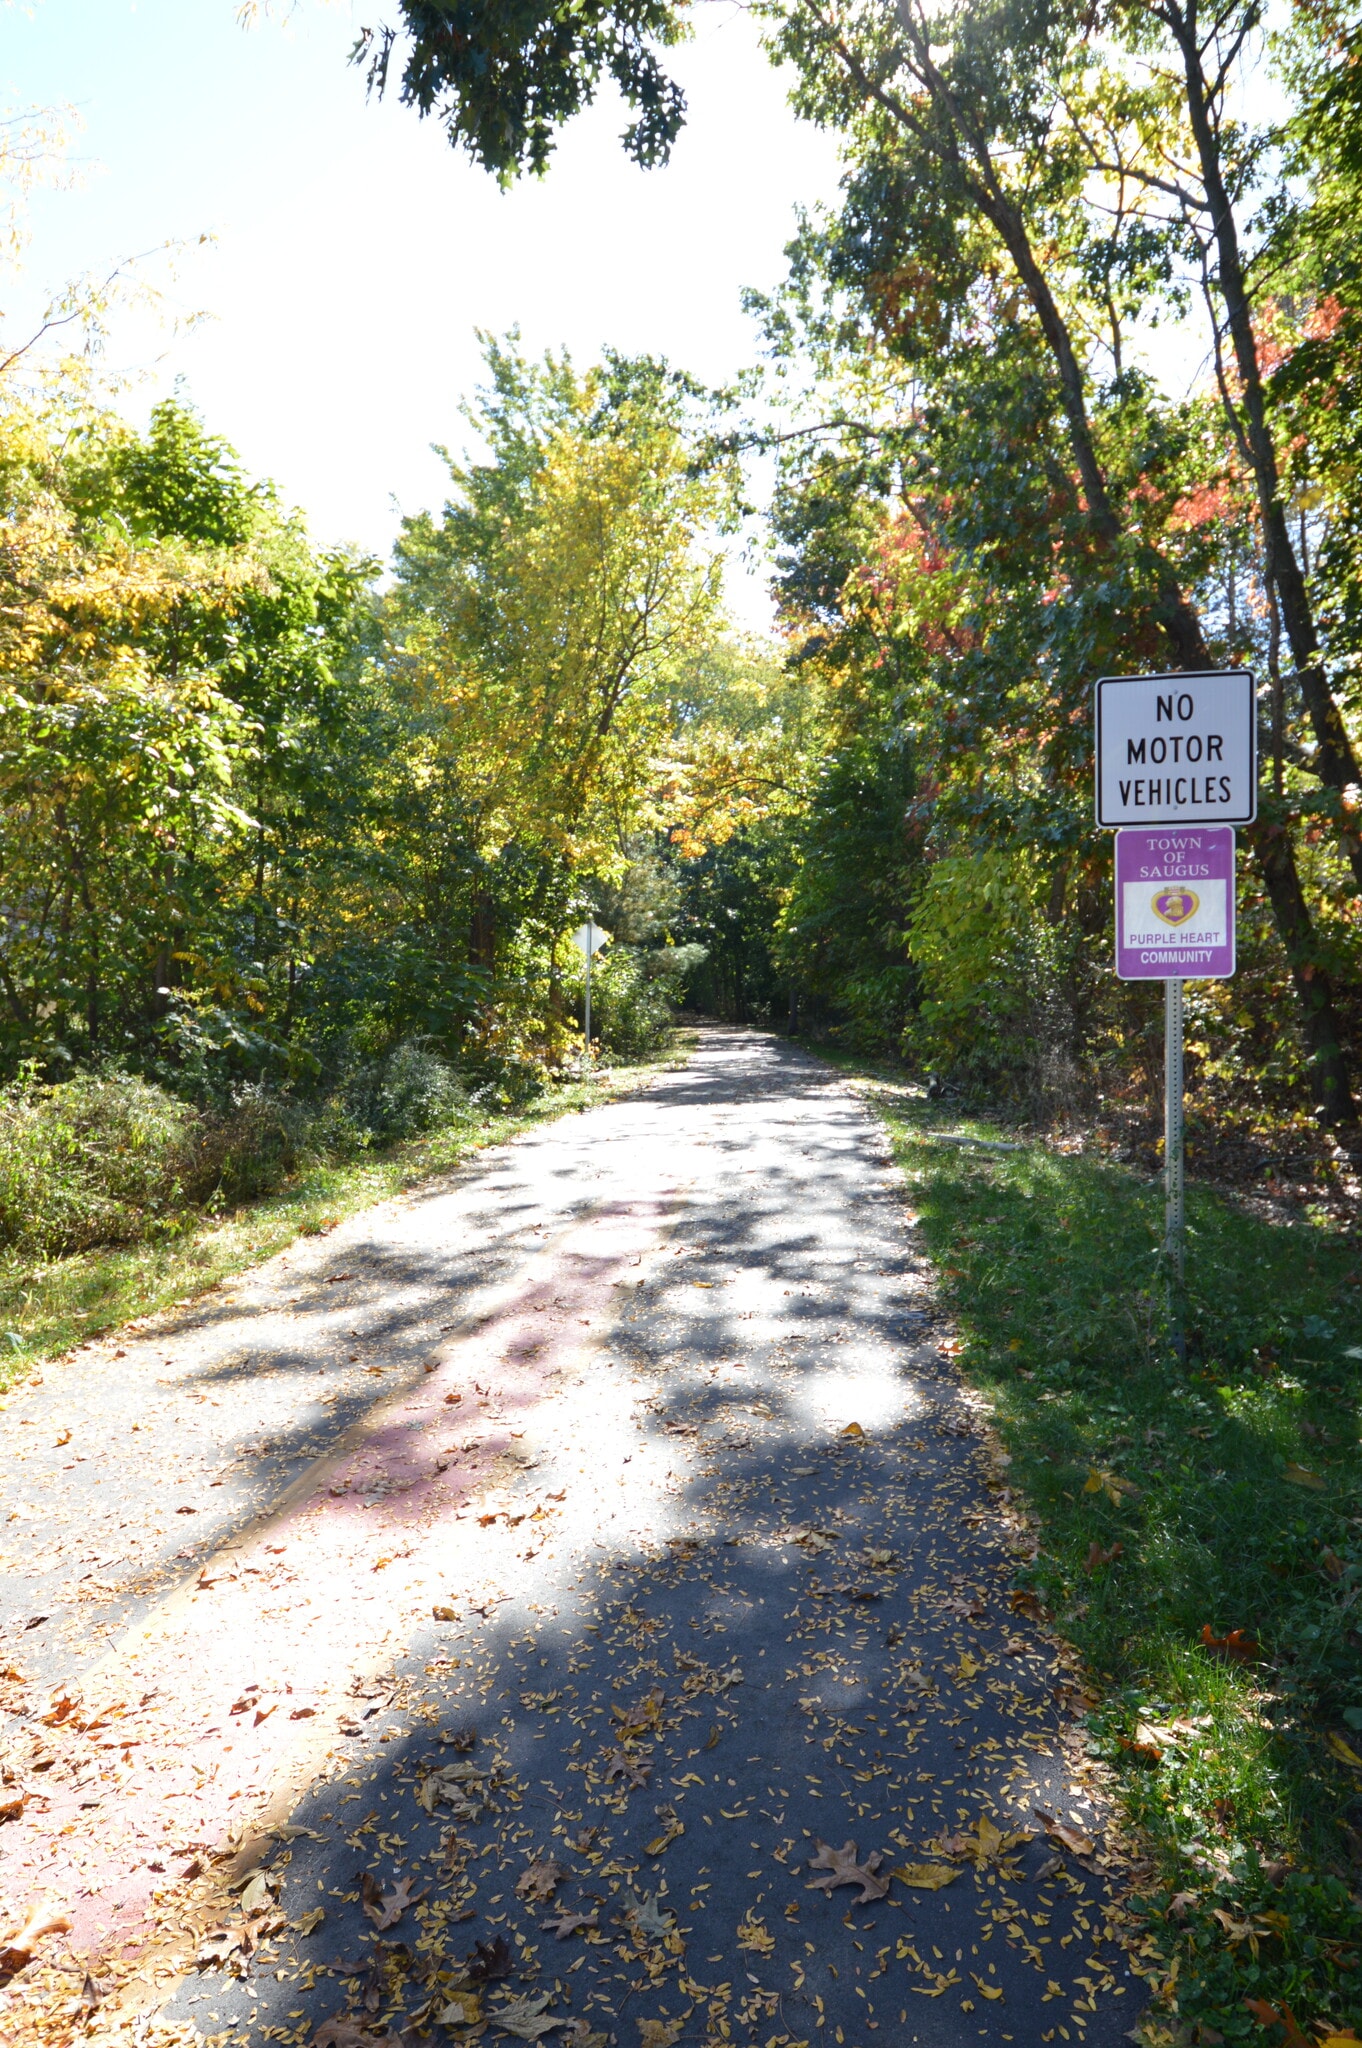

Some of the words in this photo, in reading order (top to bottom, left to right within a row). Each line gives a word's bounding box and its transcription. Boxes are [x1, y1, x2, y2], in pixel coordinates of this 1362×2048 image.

[1156, 694, 1194, 722] NO
[1127, 735, 1223, 764] MOTOR
[1119, 776, 1231, 806] VEHICLES
[1147, 837, 1202, 850] TOWN
[1164, 852, 1185, 864] OF
[1140, 864, 1209, 878] SAUGUS
[1130, 933, 1176, 945] PURPLE
[1180, 932, 1220, 943] HEART
[1141, 951, 1213, 964] COMMUNITY
